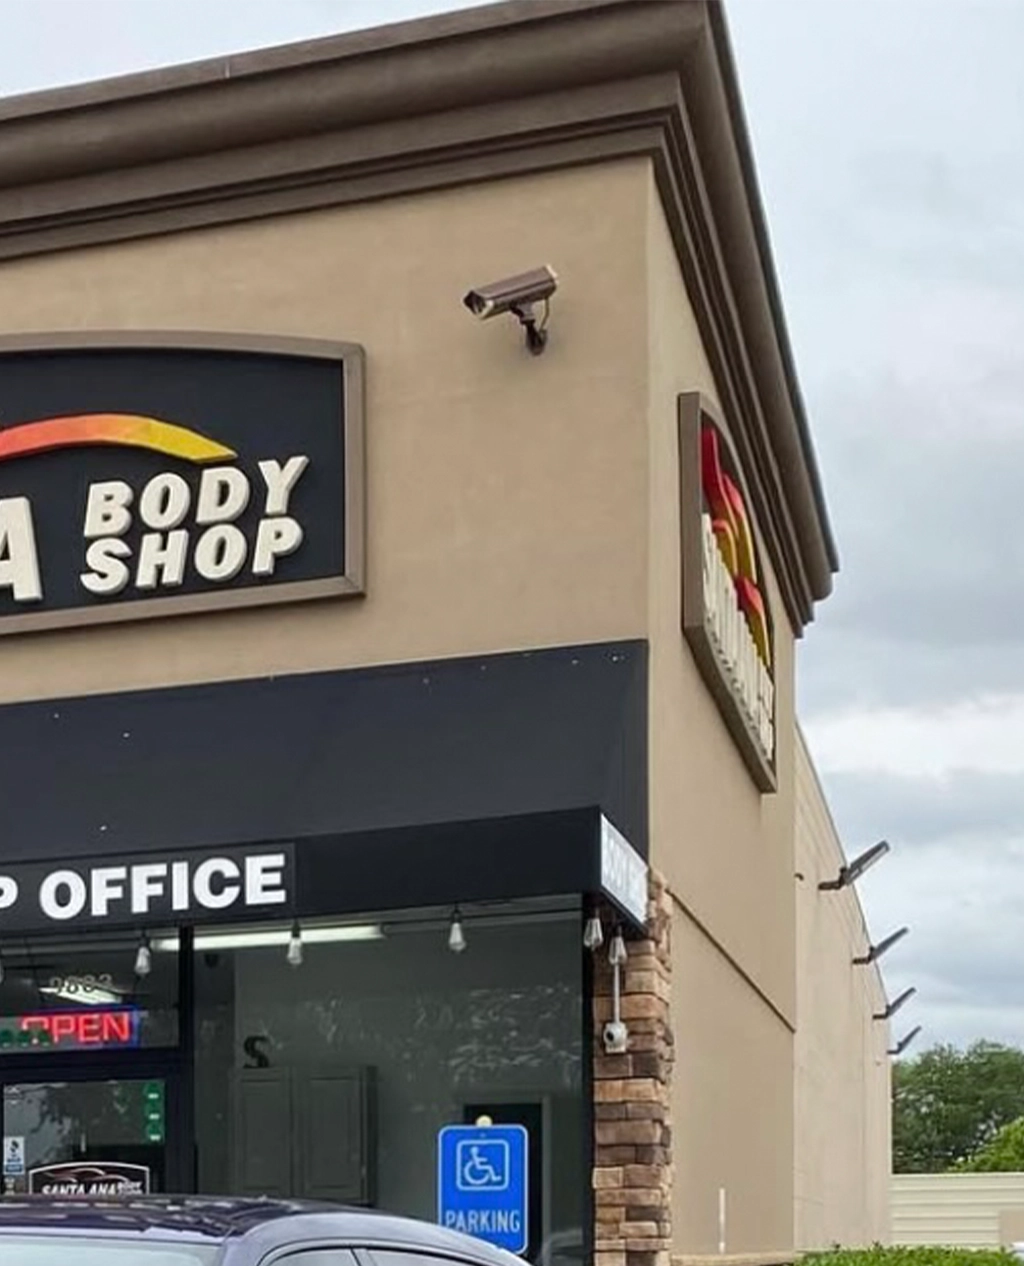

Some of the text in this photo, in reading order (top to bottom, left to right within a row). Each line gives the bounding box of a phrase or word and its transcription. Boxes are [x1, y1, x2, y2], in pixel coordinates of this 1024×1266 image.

[83, 456, 309, 538] BODY
[79, 517, 303, 594] SHOP
[39, 854, 286, 920] OFFICE
[22, 1011, 129, 1043] OPEN
[445, 1210, 521, 1234] PARKING
